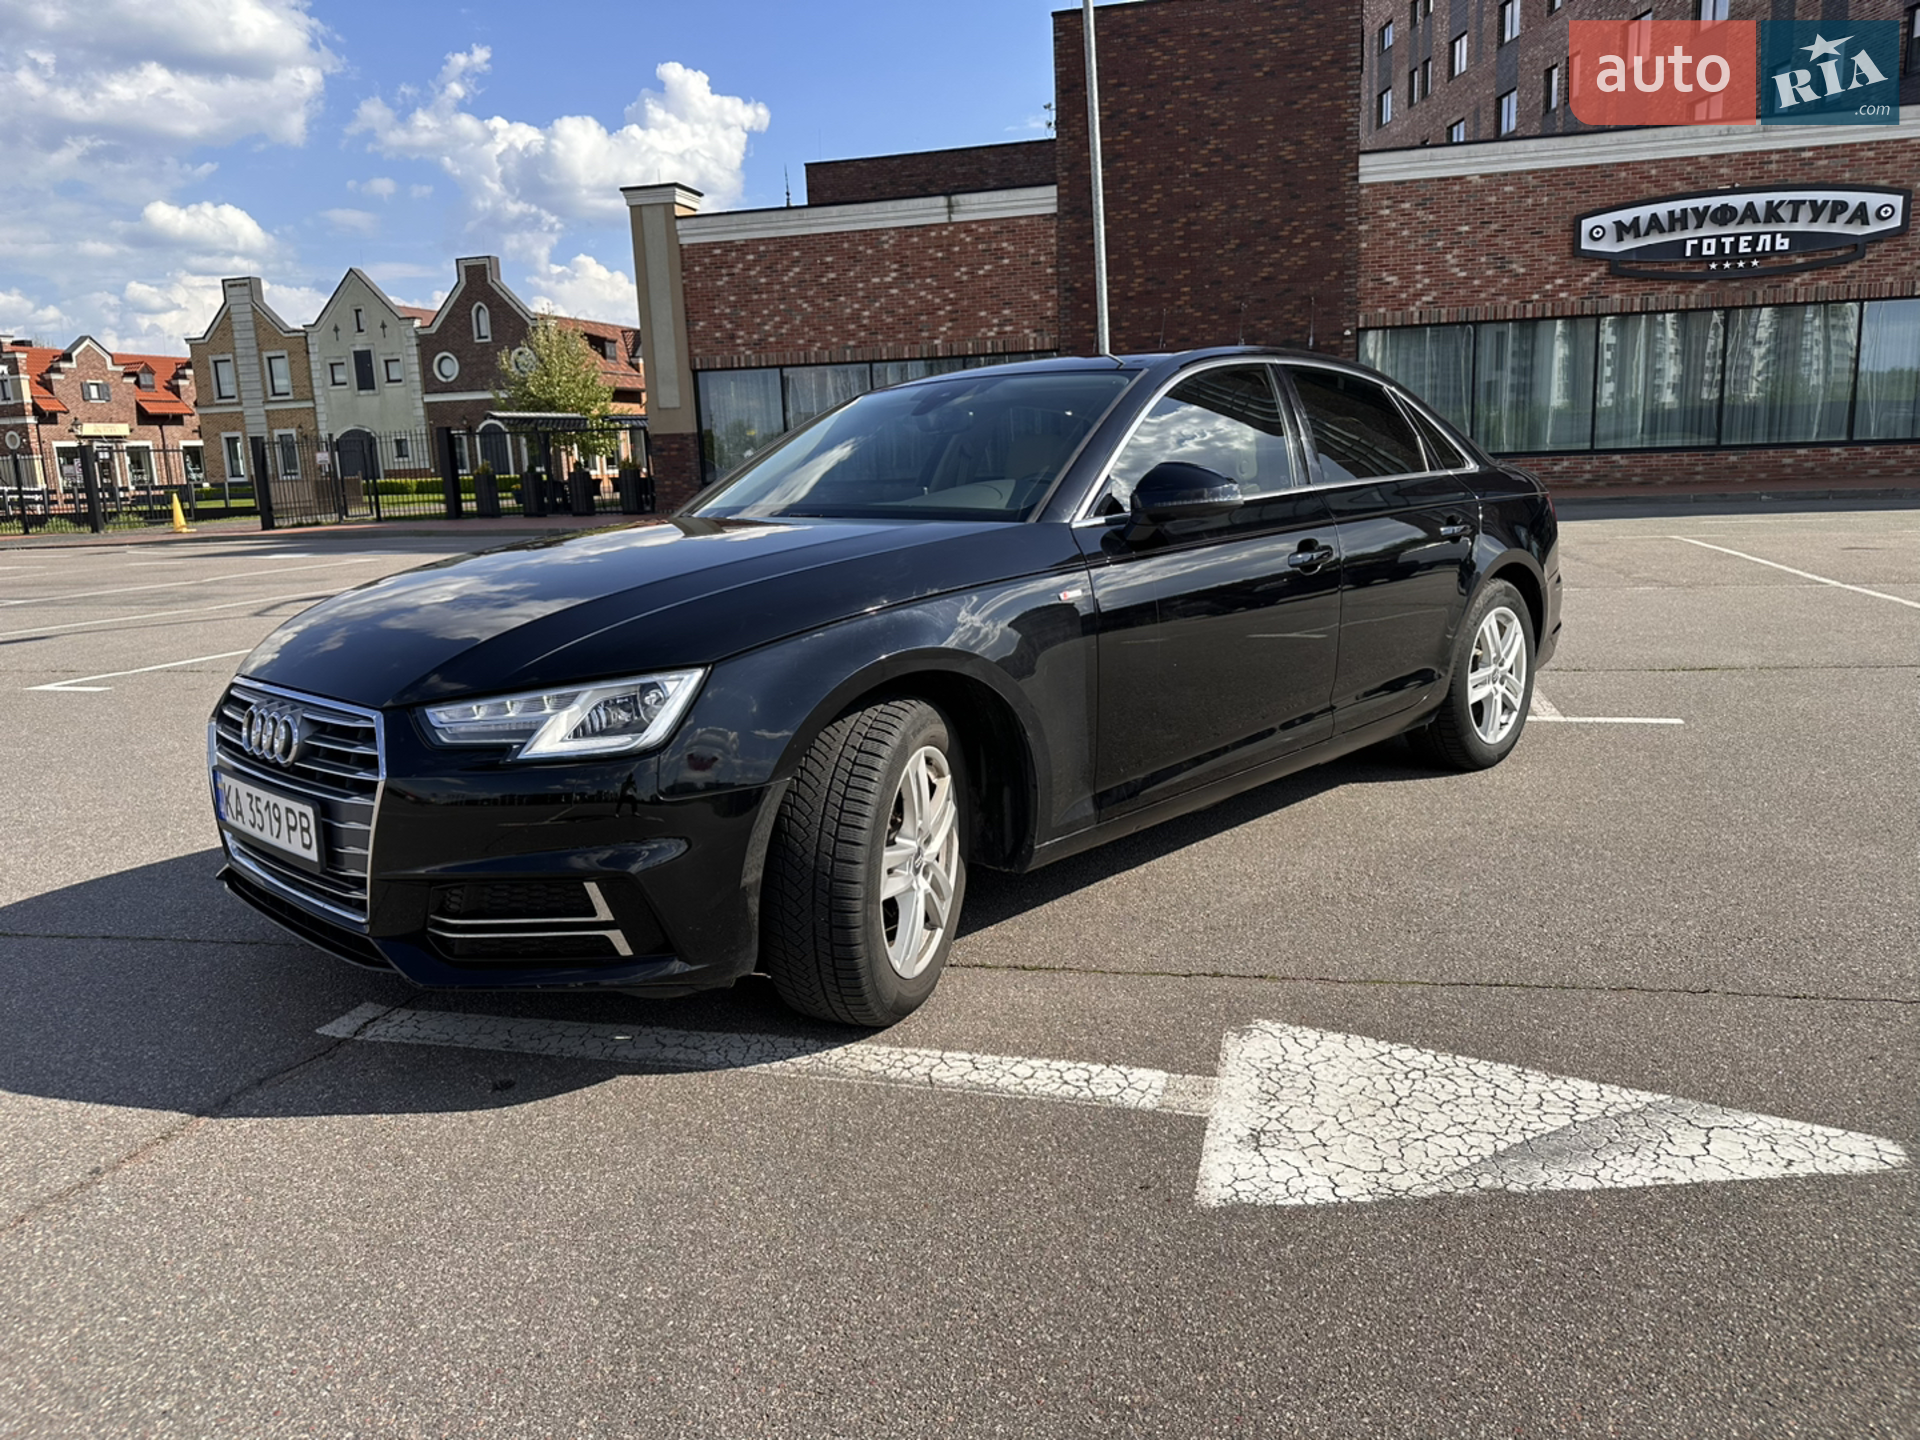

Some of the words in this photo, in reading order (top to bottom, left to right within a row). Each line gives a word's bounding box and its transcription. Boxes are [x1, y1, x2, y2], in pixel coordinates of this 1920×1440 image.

[1612, 200, 1871, 242] МАНУФАКТУРА
[1684, 233, 1790, 257] ГОТЕЛЬ
[224, 783, 245, 824] KA
[246, 792, 281, 839] 3519
[285, 806, 313, 851] PB
